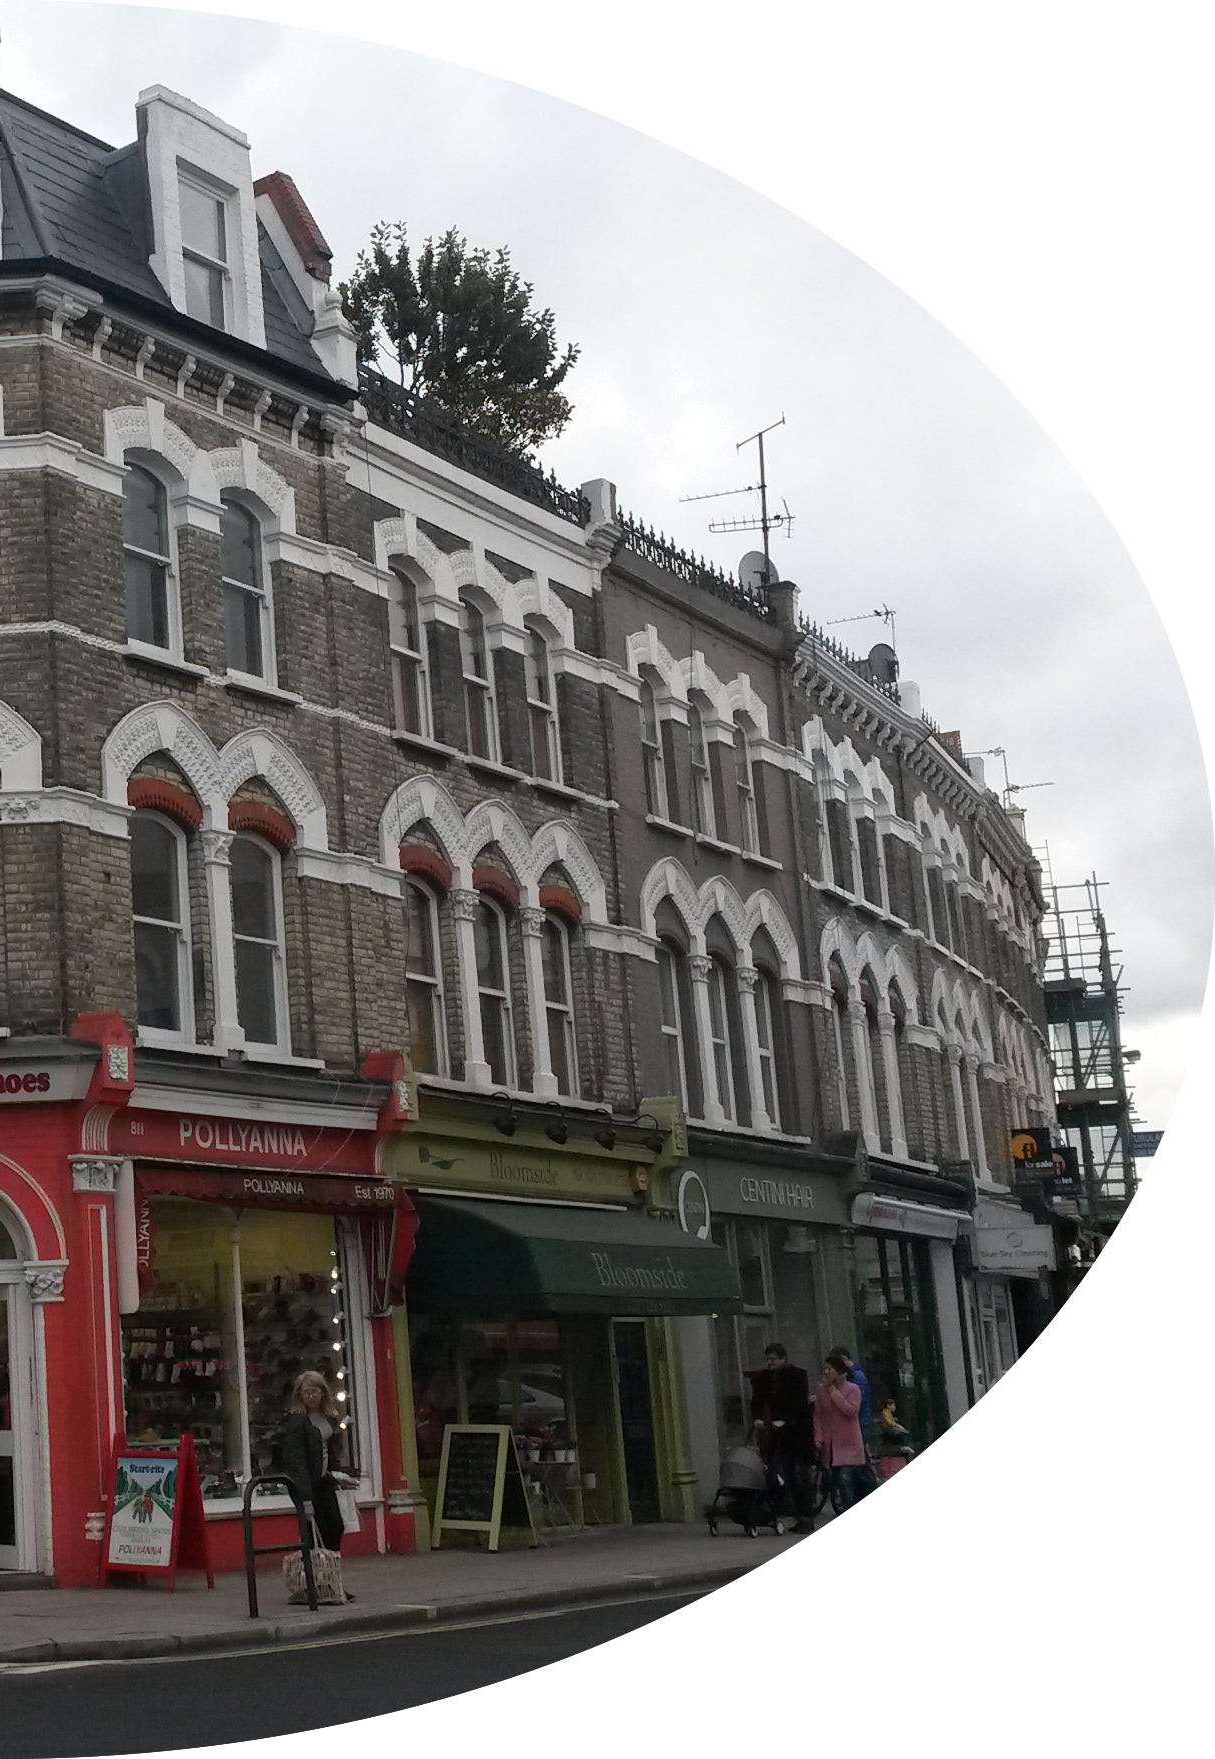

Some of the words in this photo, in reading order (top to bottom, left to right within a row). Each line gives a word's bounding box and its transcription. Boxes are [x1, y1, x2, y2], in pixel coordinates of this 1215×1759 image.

[130, 1121, 144, 1136] 811
[179, 1118, 308, 1157] POLLYANNA
[490, 1153, 558, 1186] Bloomside
[243, 1178, 305, 1195] POLLYANNA
[354, 1184, 372, 1199] Est
[373, 1185, 395, 1200] 1970
[740, 1177, 785, 1206] CENTINI
[786, 1183, 814, 1209] HAIR
[591, 1252, 688, 1289] Bloomside
[129, 1463, 165, 1474] Start-rite
[118, 1544, 163, 1556] POLLYANNA
